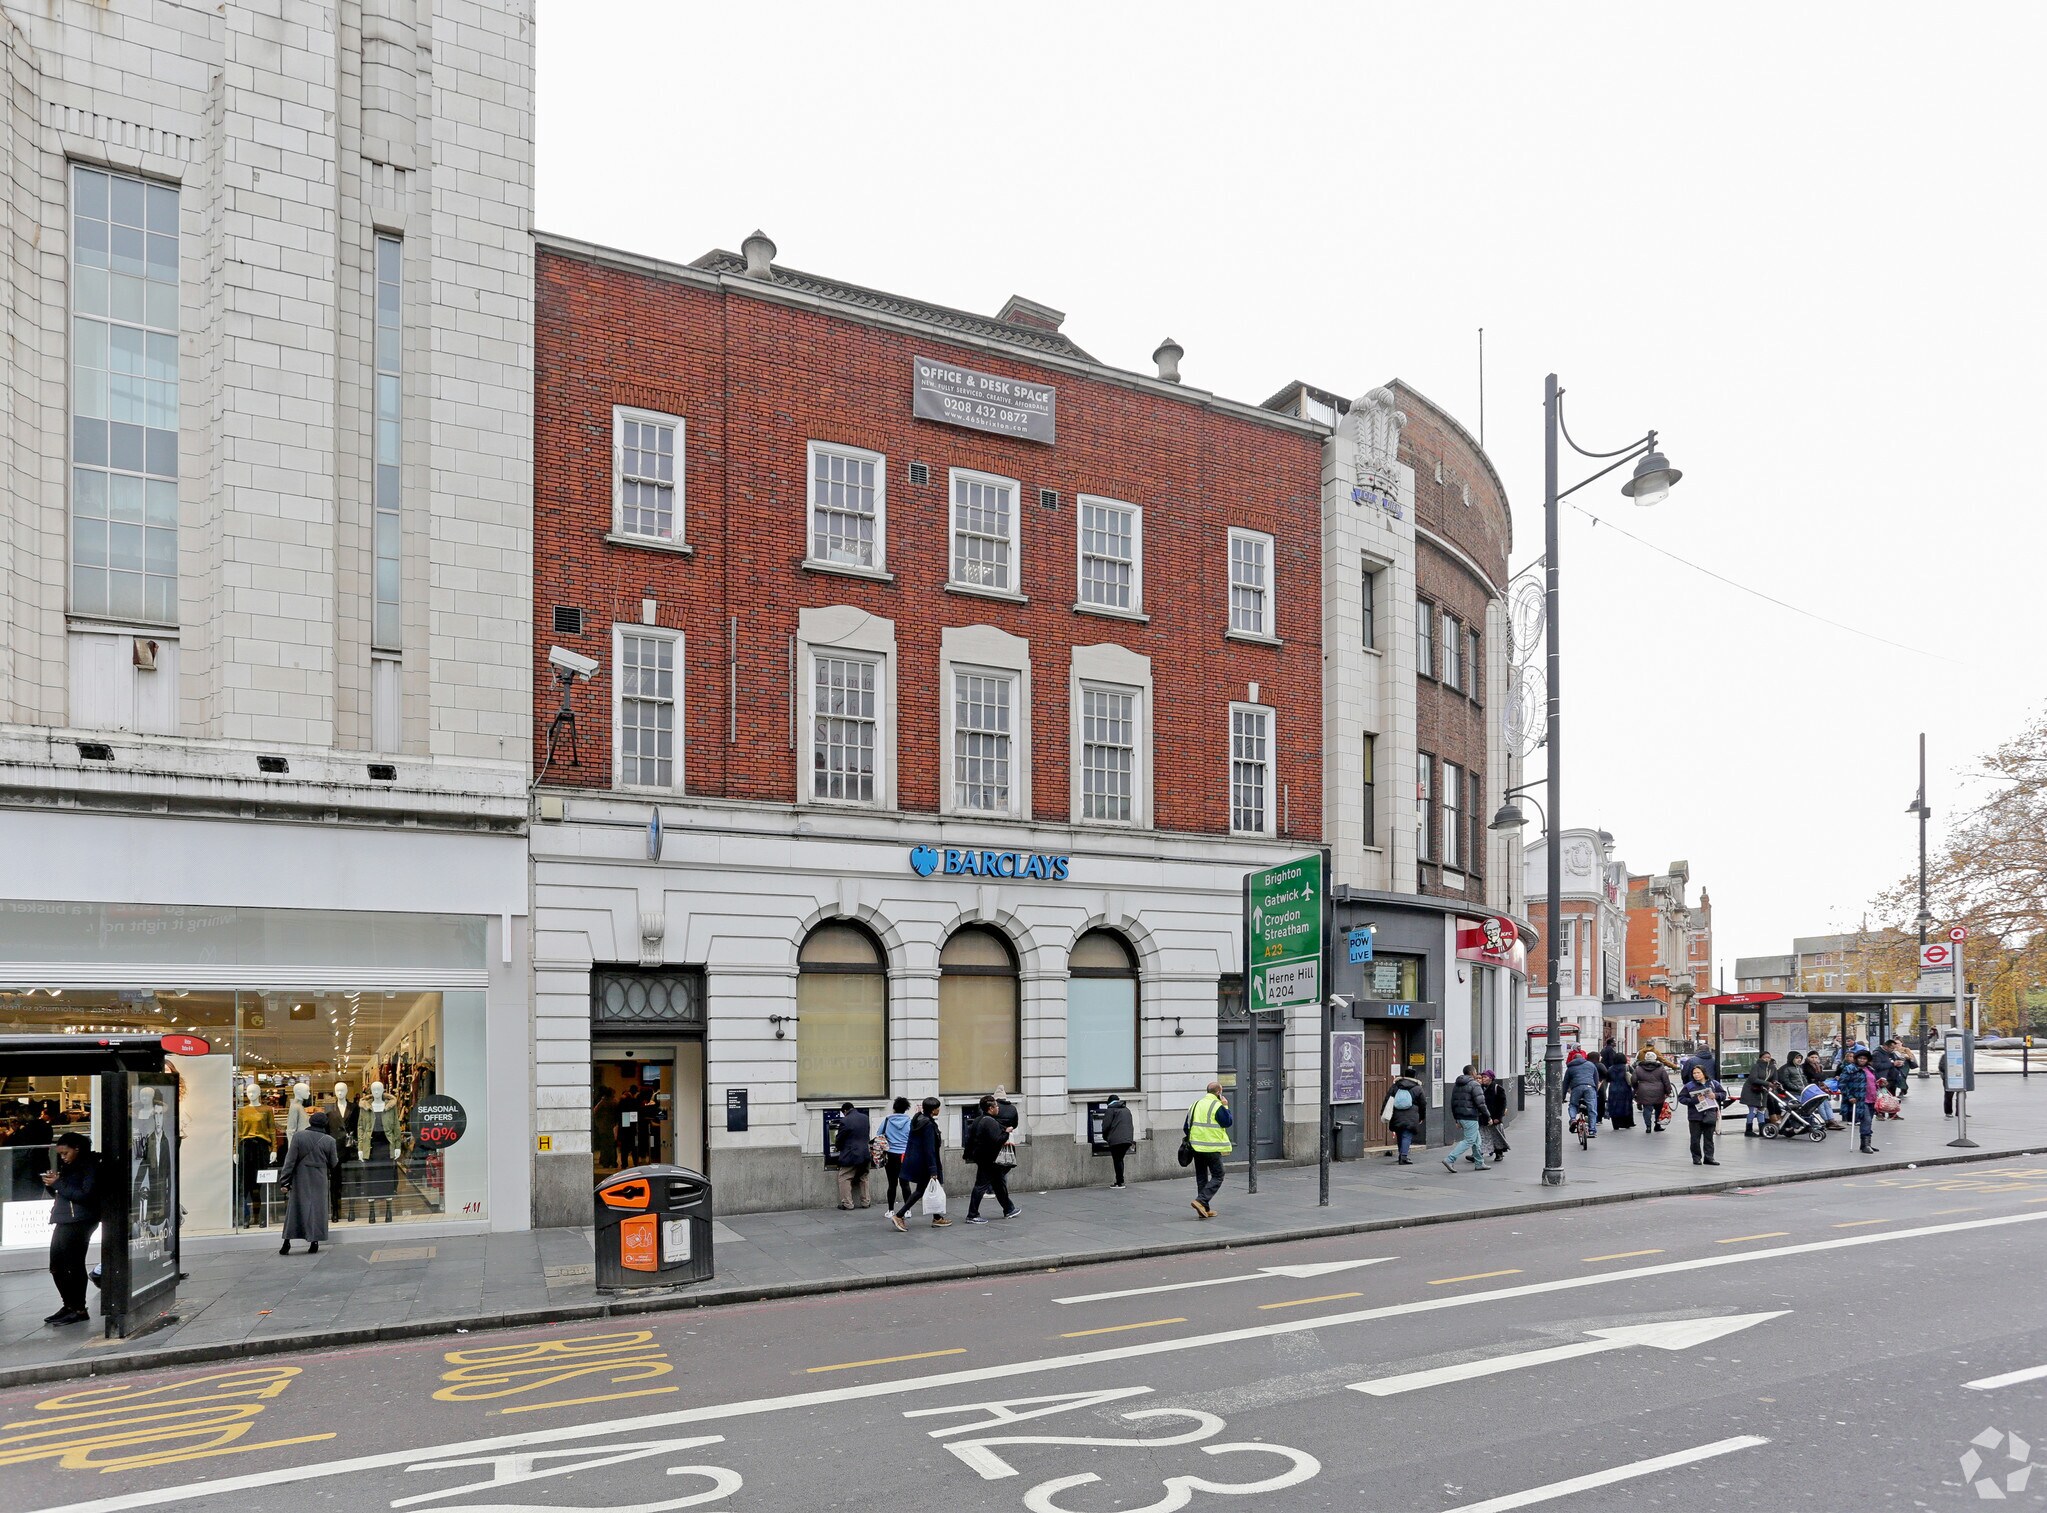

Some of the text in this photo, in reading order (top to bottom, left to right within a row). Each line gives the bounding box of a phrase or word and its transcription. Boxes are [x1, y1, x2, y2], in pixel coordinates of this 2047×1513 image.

[920, 366, 1048, 403] OFFICE & DESK SPACE
[938, 384, 954, 392] FULLY
[1015, 400, 1048, 412] AFFORDABLE
[944, 397, 1028, 424] 0208 432 0872
[944, 411, 1028, 432] www.465brixton.com
[944, 849, 1070, 880] BARCLAYS
[1265, 867, 1302, 886] Brighton
[1265, 889, 1299, 907] Gatwick
[1265, 909, 1301, 927] Croydon
[1265, 922, 1309, 941] Streatham
[1265, 943, 1283, 957] A23
[1350, 937, 1369, 949] POW
[1351, 950, 1369, 961] LIVE
[1269, 967, 1314, 985] Herne Hill
[1269, 985, 1294, 999] A204
[1387, 1004, 1410, 1016] LIVE
[418, 1105, 458, 1113] SEASONAL
[424, 1113, 453, 1121] OFFERS
[420, 1127, 457, 1141] 50%
[540, 1136, 549, 1149] H
[132, 1236, 151, 1251] NEW
[149, 1250, 160, 1262] MEN
[431, 1330, 675, 1401] BUS
[902, 1385, 1323, 1513] A23
